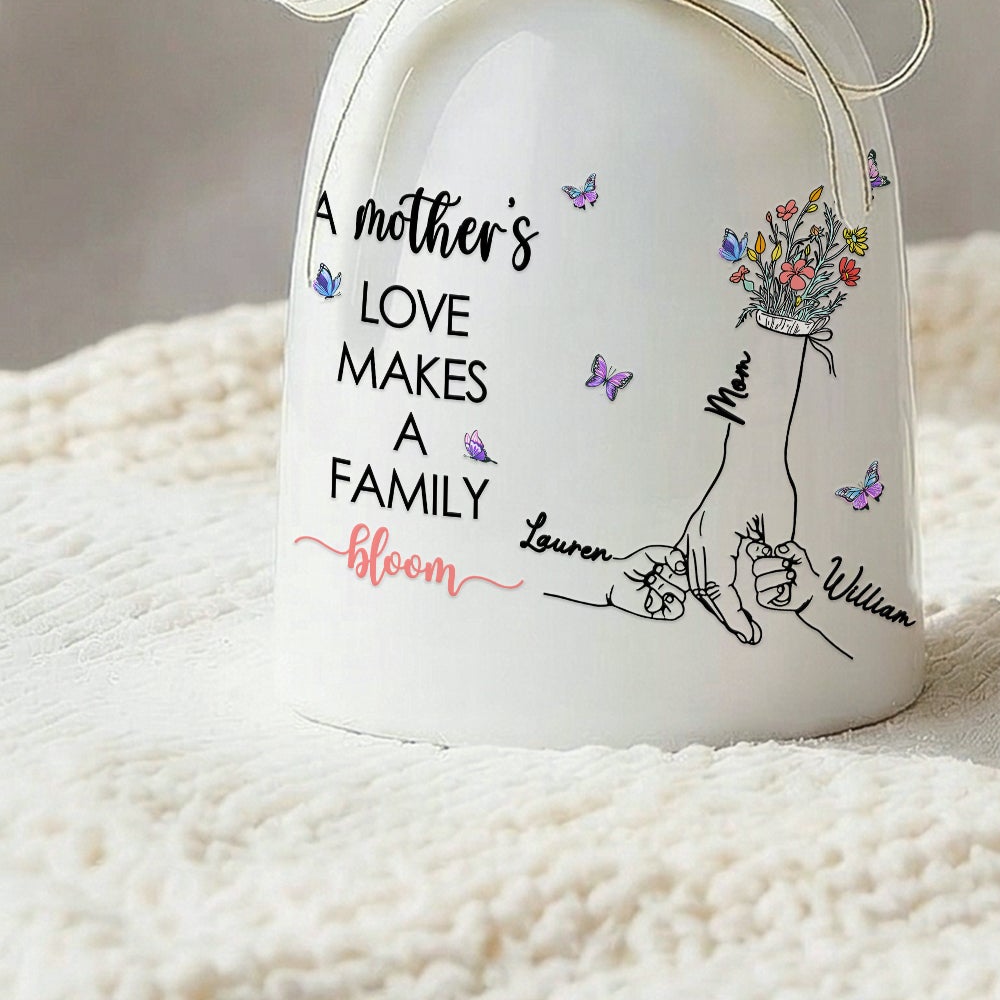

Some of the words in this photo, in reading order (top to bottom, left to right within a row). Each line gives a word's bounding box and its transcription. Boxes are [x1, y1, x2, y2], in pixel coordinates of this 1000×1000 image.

[315, 190, 338, 235] A
[354, 187, 540, 272] mother's
[360, 280, 471, 338] LOVE
[337, 341, 489, 404] MAKES
[704, 351, 751, 426] Mom
[393, 412, 428, 456] A
[330, 457, 490, 520] FAMILY
[294, 523, 524, 598] bloom
[519, 512, 613, 562] Lauren
[822, 556, 916, 629] William
